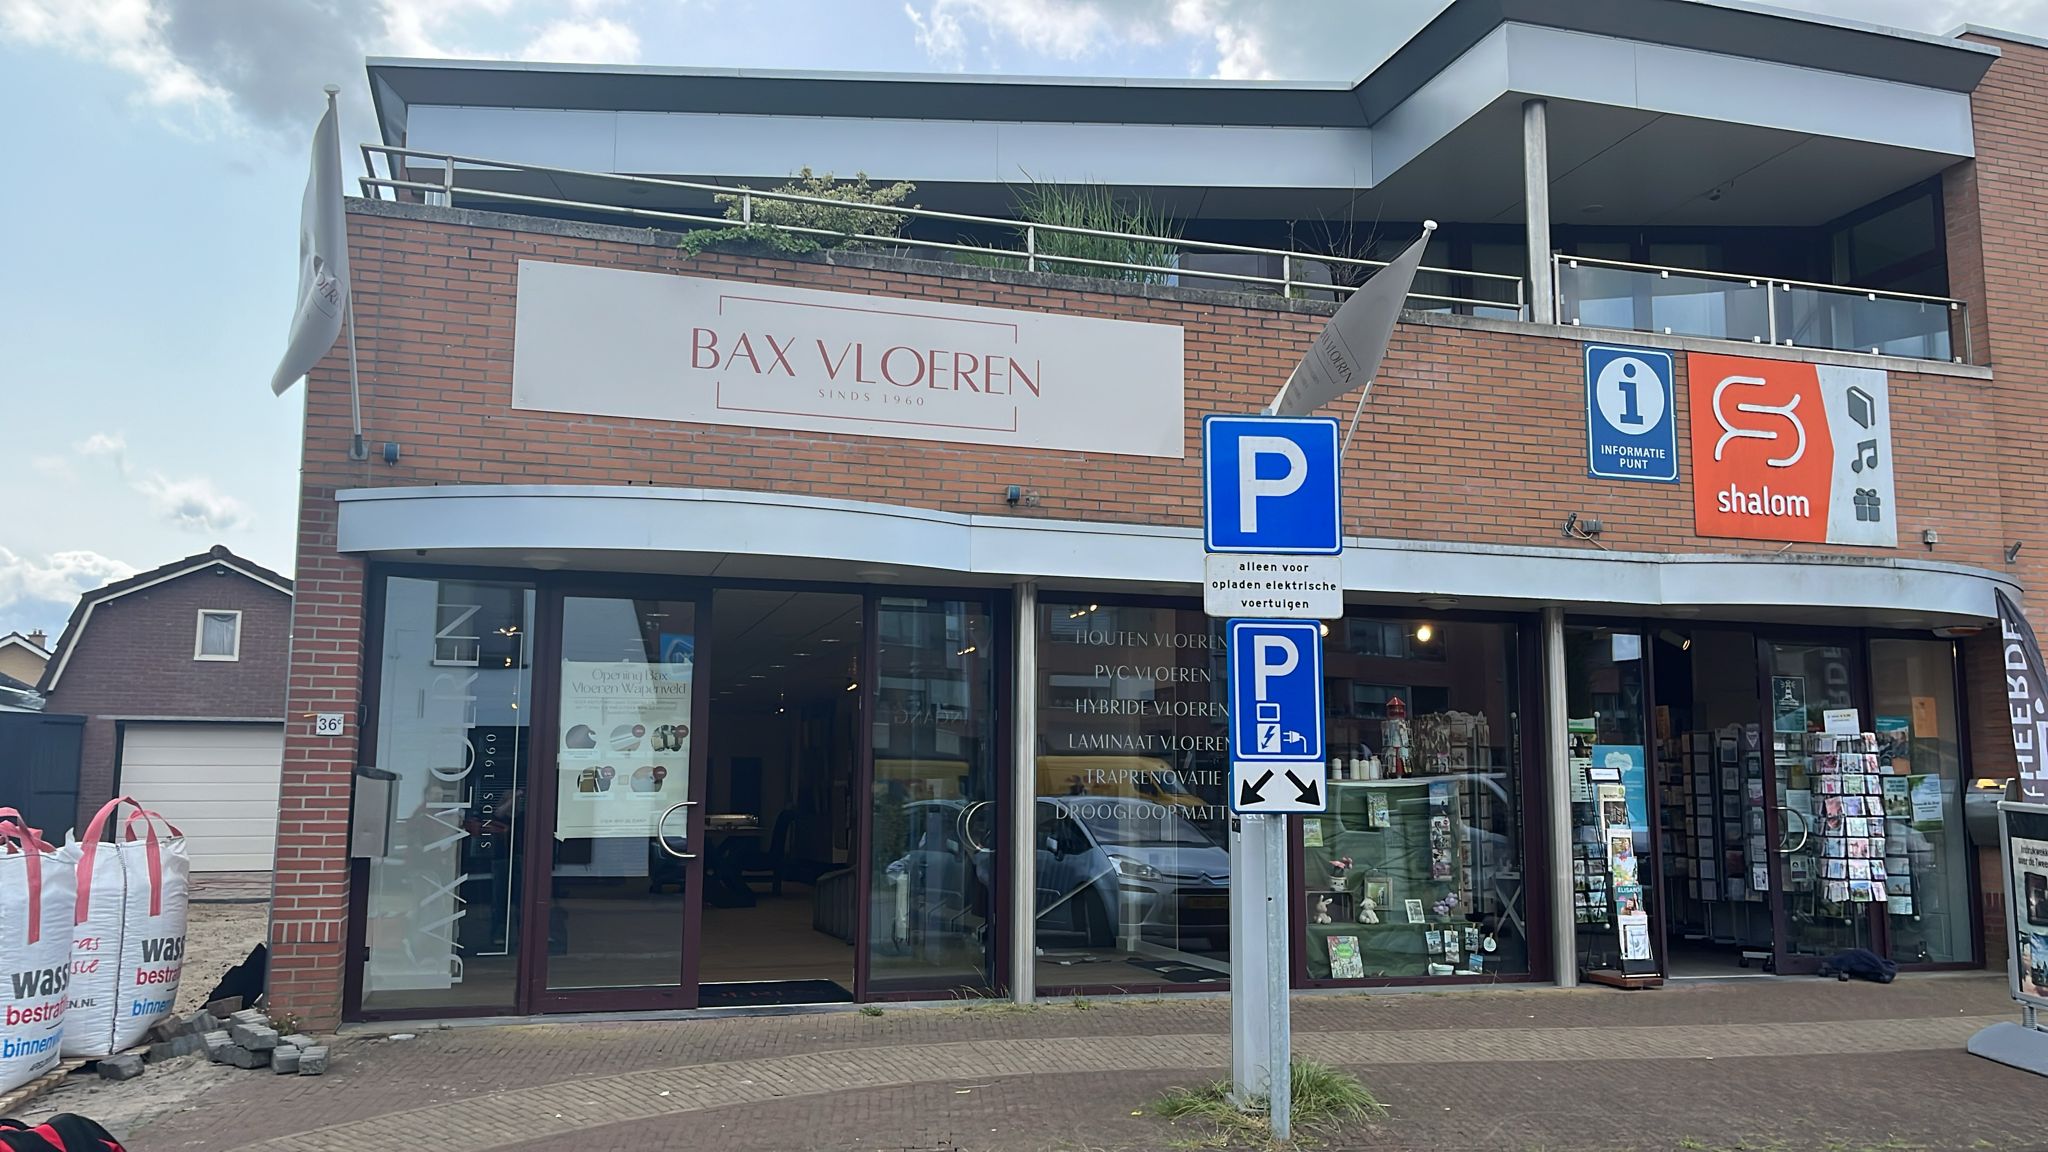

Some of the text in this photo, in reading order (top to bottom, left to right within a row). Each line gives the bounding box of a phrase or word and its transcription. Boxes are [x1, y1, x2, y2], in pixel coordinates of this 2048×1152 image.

[691, 327, 1040, 398] BAX VLOEREN
[818, 388, 925, 407] SINDS 1960
[1600, 444, 1666, 460] INFORMATIE
[1619, 457, 1649, 470] PUNT
[1238, 435, 1308, 533] P
[1717, 482, 1810, 519] shalom
[1239, 561, 1310, 573] alleen voor
[1212, 579, 1337, 593] opladen elektrische
[1241, 598, 1310, 611] voertuigen
[1076, 629, 1148, 647] HOUTEN
[591, 668, 643, 684] Opening
[1095, 664, 1211, 683] PVC VLOEREN
[1253, 635, 1299, 701] P
[572, 681, 686, 697] Vloeren Wapenveld
[1076, 698, 1148, 715] HYBRIDE
[1069, 733, 1155, 750] LAMINAAT
[1086, 768, 1222, 786] TRAPRENOVATIE
[418, 604, 483, 984] BAX VLOEREN
[480, 732, 497, 849] SINDS 1960
[1056, 803, 1176, 820] DROOGLOOP
